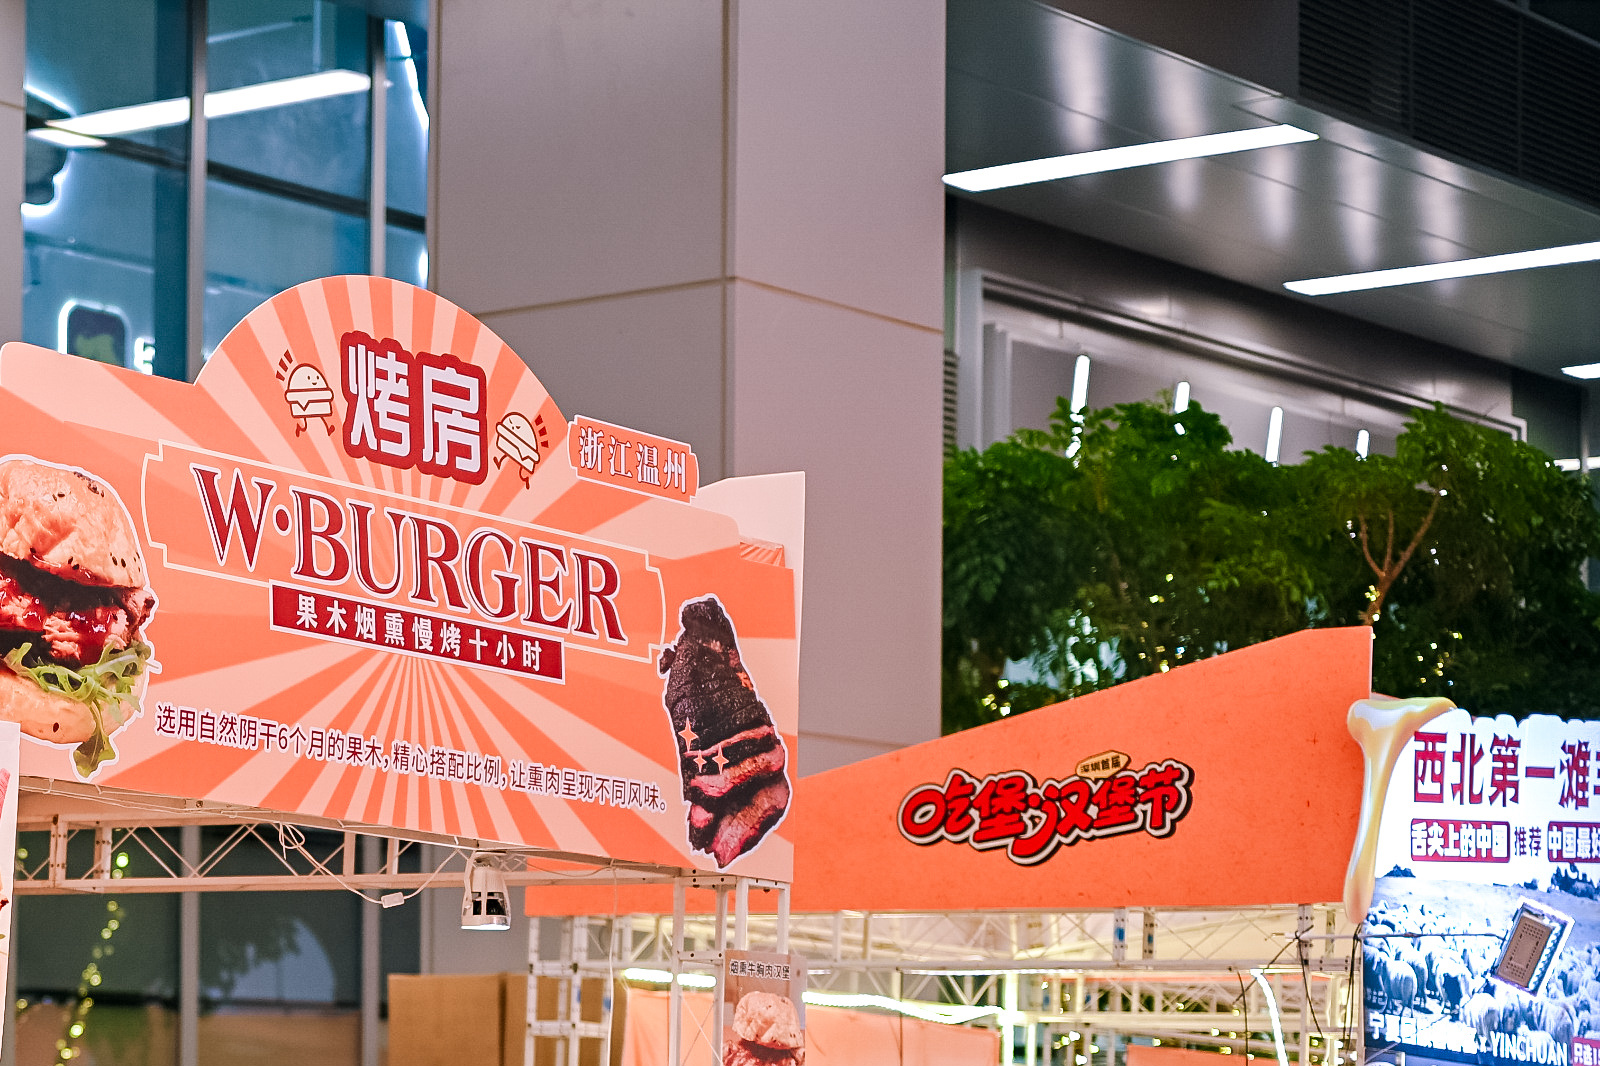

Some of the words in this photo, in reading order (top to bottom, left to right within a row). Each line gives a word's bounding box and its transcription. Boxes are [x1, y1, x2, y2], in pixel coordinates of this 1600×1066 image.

[347, 341, 482, 476] 烤房
[578, 425, 689, 495] 浙江温州
[294, 594, 544, 672] 果木烟熏慢烤十小时
[1413, 731, 1600, 811] 西北第一滩
[1513, 826, 1542, 857] 推荐
